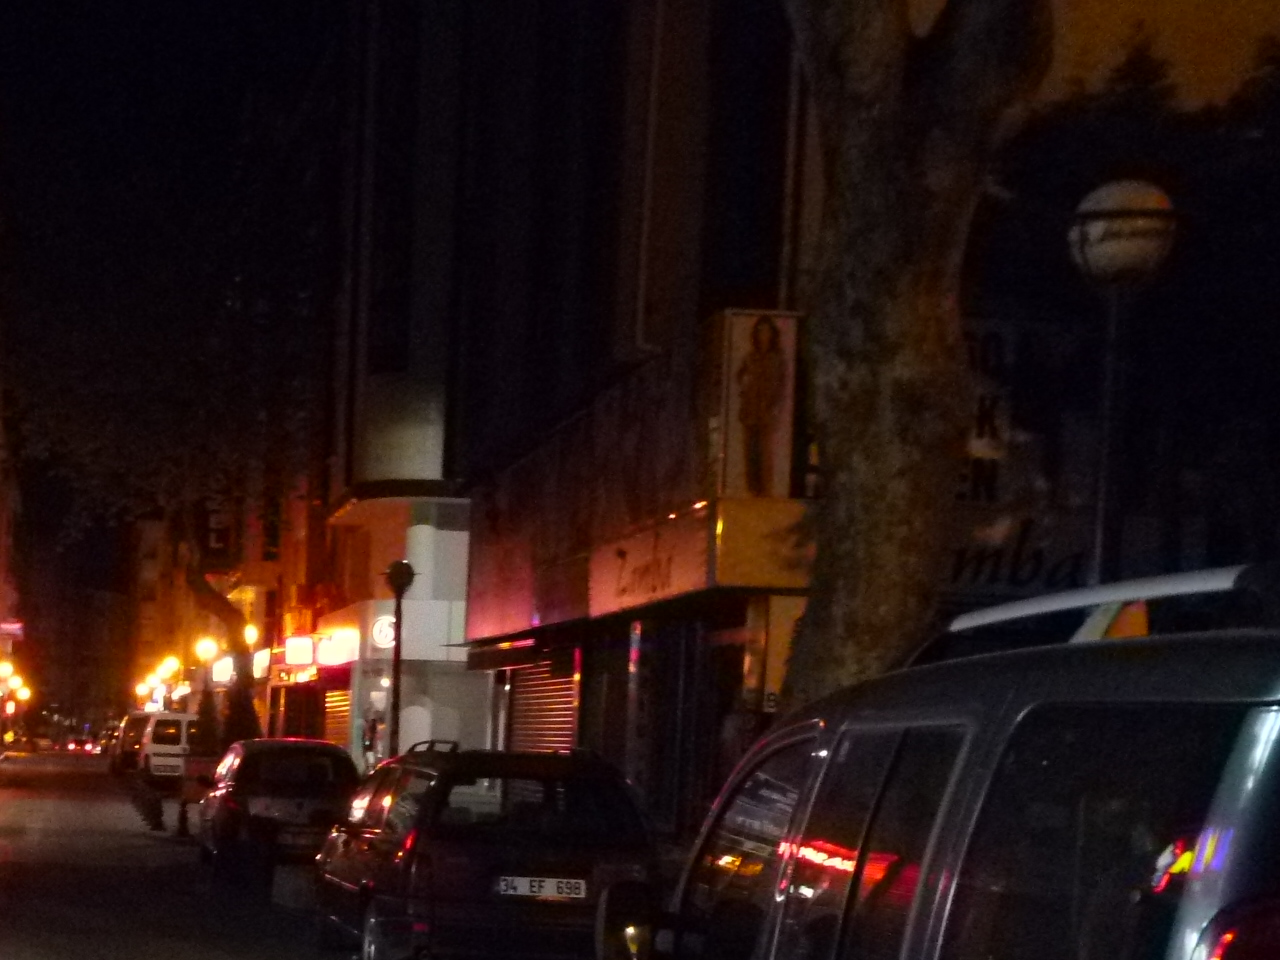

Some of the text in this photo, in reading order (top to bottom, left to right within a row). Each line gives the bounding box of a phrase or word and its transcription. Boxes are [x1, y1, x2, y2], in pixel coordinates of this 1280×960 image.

[501, 879, 581, 896] 34 EF 698
